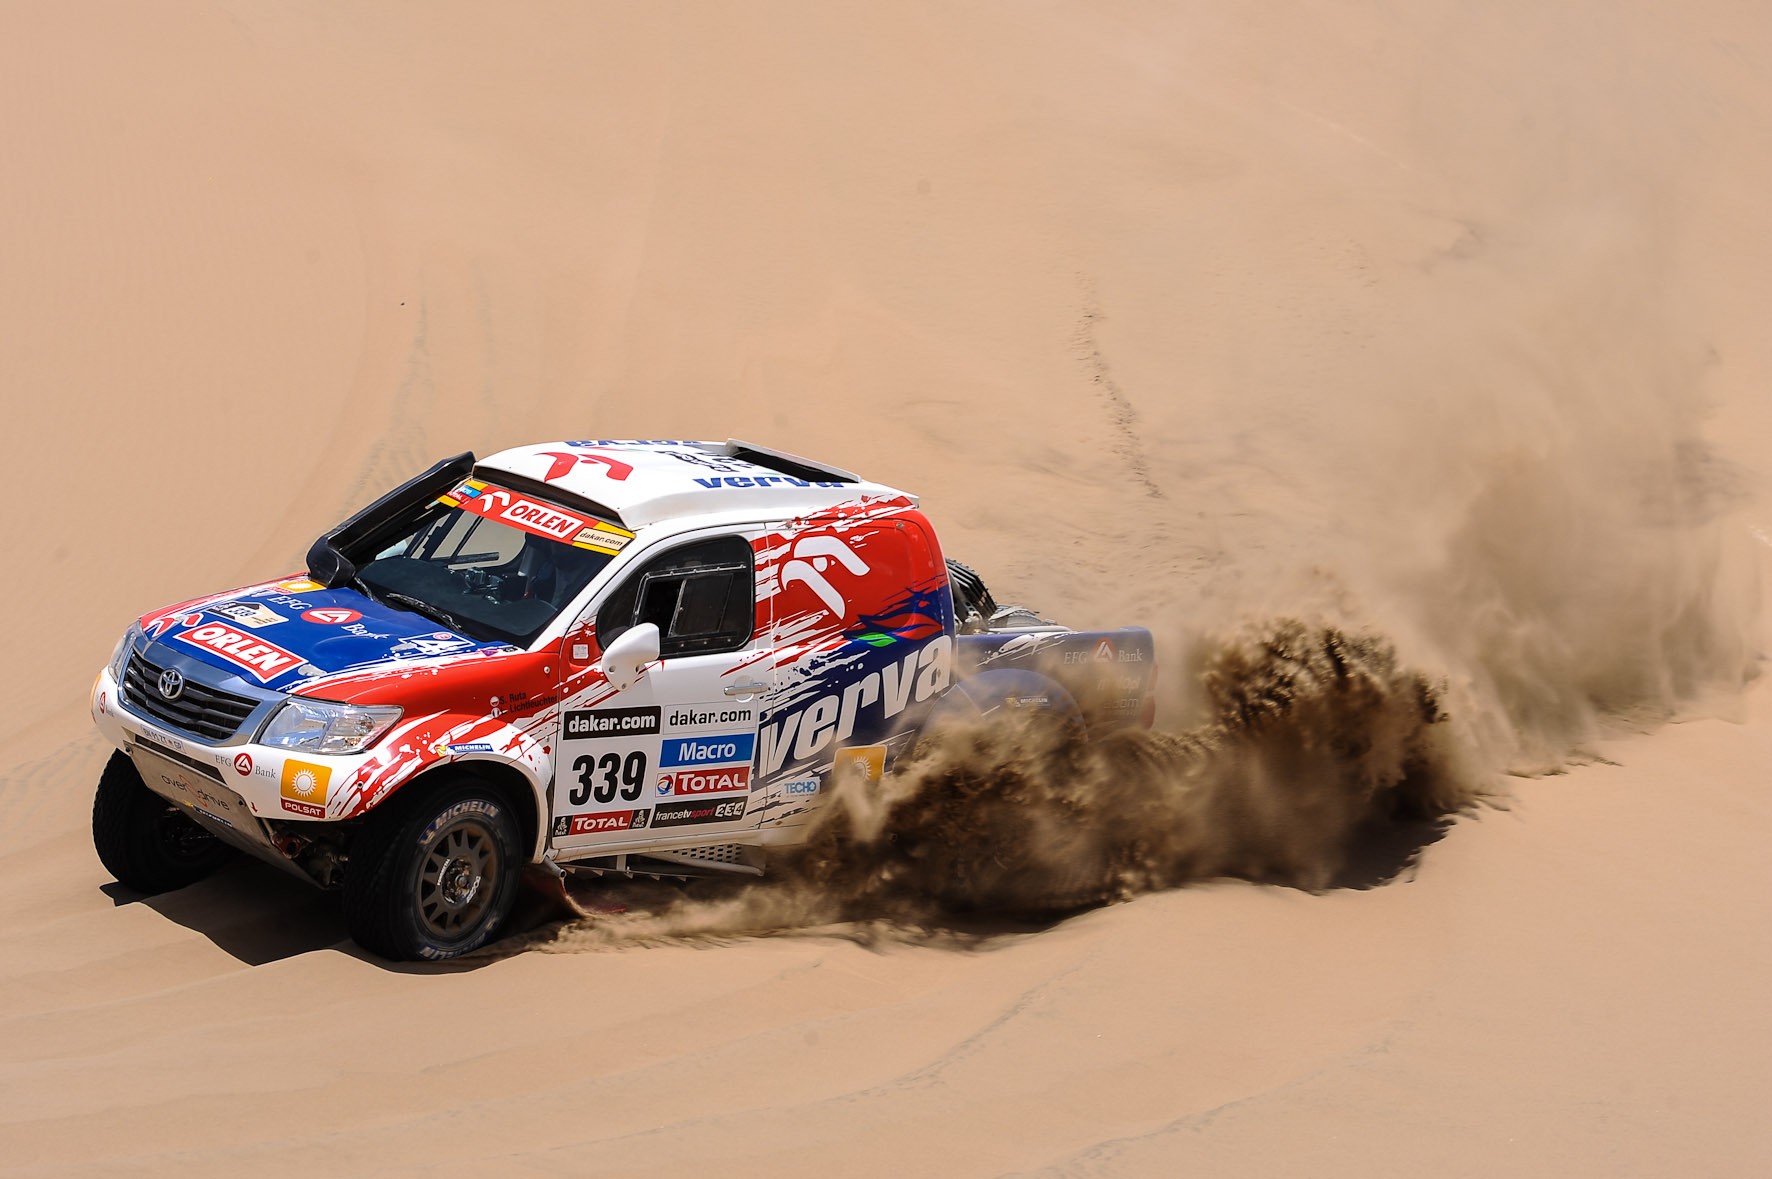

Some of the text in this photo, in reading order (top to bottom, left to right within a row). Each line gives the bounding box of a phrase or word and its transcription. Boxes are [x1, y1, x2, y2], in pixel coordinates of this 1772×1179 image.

[510, 505, 575, 534] ORLEN
[579, 531, 623, 547] dakar.com
[267, 596, 312, 610] EFG
[192, 627, 292, 671] ORLEN
[1063, 649, 1143, 665] EFG Bank
[509, 691, 527, 701] Ruta
[758, 634, 952, 779] verva
[568, 714, 656, 733] dakar.com
[669, 709, 751, 726] dakar.com
[678, 742, 736, 761] Macro
[215, 754, 276, 779] EFG Bank
[569, 750, 647, 806] 339
[679, 773, 746, 791] TOTAL
[161, 775, 230, 811] over drive
[784, 781, 817, 794] TECHO
[285, 802, 322, 816] POLSAT
[434, 800, 500, 830] MICHELIN
[655, 808, 715, 821] francetvsport
[574, 815, 629, 831] TOTAL
